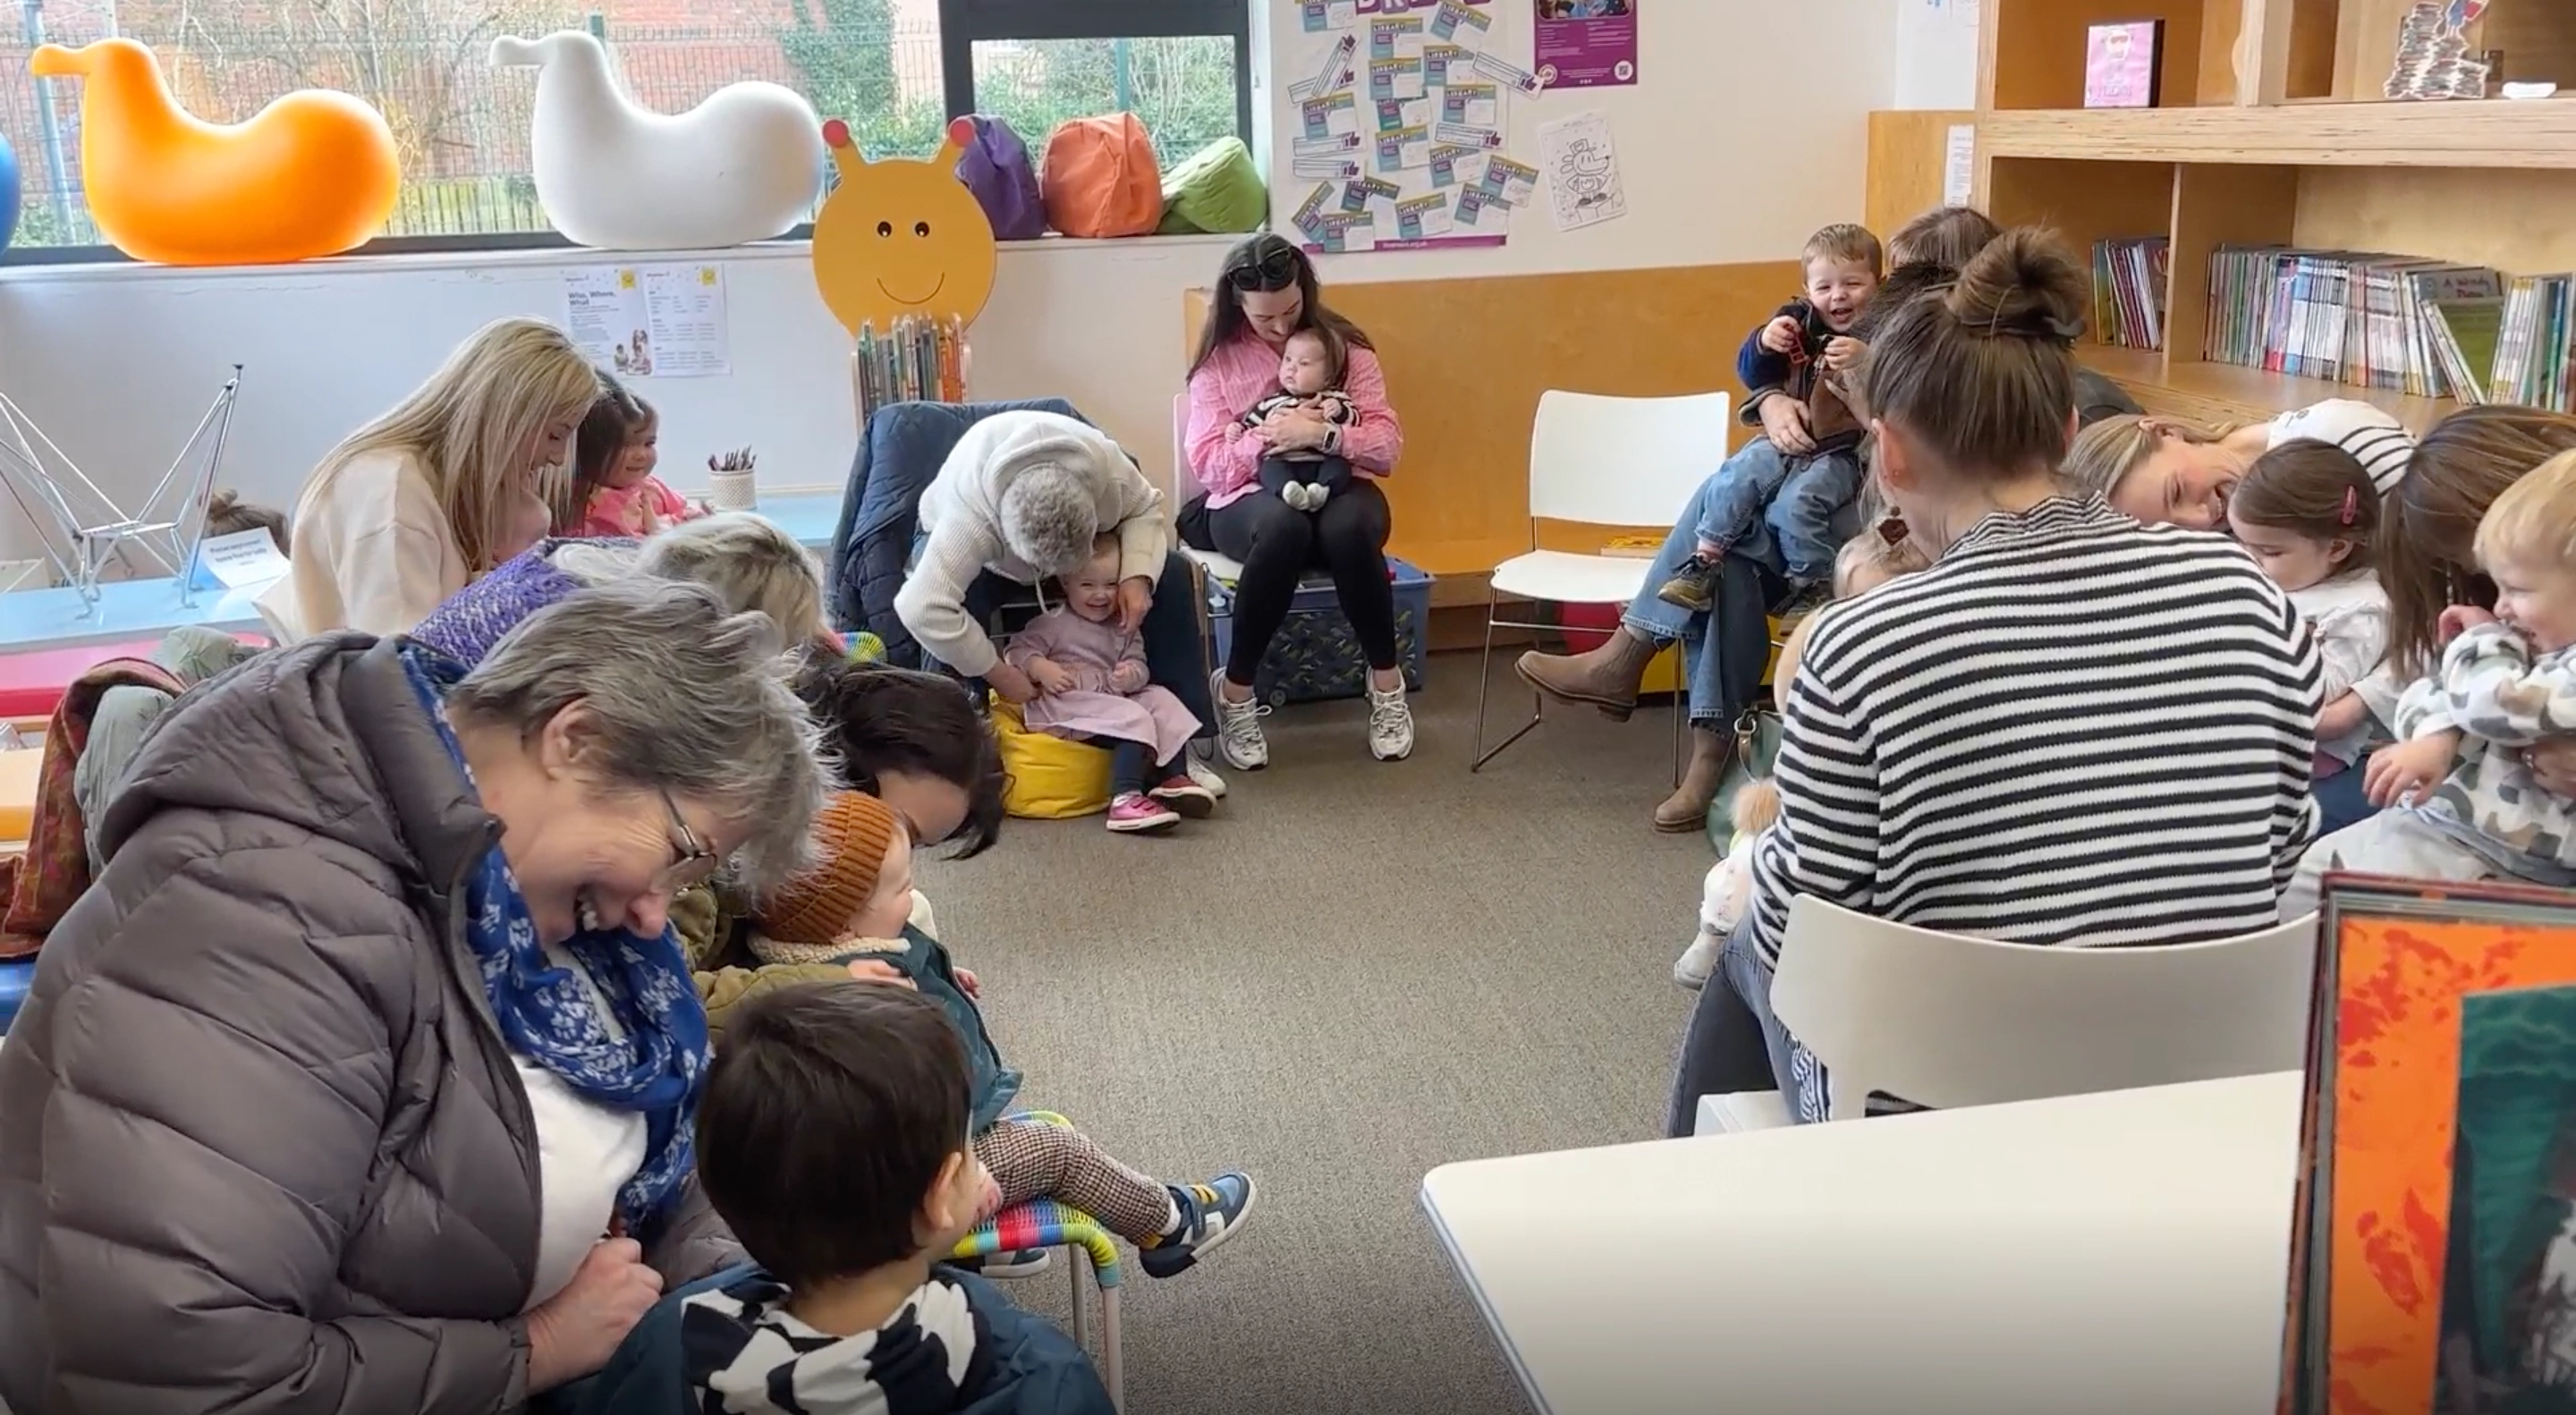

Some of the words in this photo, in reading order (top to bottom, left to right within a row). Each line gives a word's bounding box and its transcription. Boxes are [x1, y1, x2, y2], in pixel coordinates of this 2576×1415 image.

[1443, 3, 1473, 21] LIBRARY
[1373, 23, 1405, 32] LIBRARY
[1427, 50, 1459, 59] LIBRARY
[1371, 64, 1403, 73] LIBRARY
[1445, 89, 1478, 97] LIBRARY
[1305, 100, 1335, 112] LIBRARY
[1377, 133, 1411, 144] LIBRARY
[1431, 148, 1462, 161] LIBRARY
[1491, 161, 1521, 176] LIBRARY
[1464, 190, 1495, 202] LIBRARY
[1399, 201, 1429, 215] LIBRARY
[1324, 217, 1356, 227] LIBRARY
[2444, 279, 2453, 288] A
